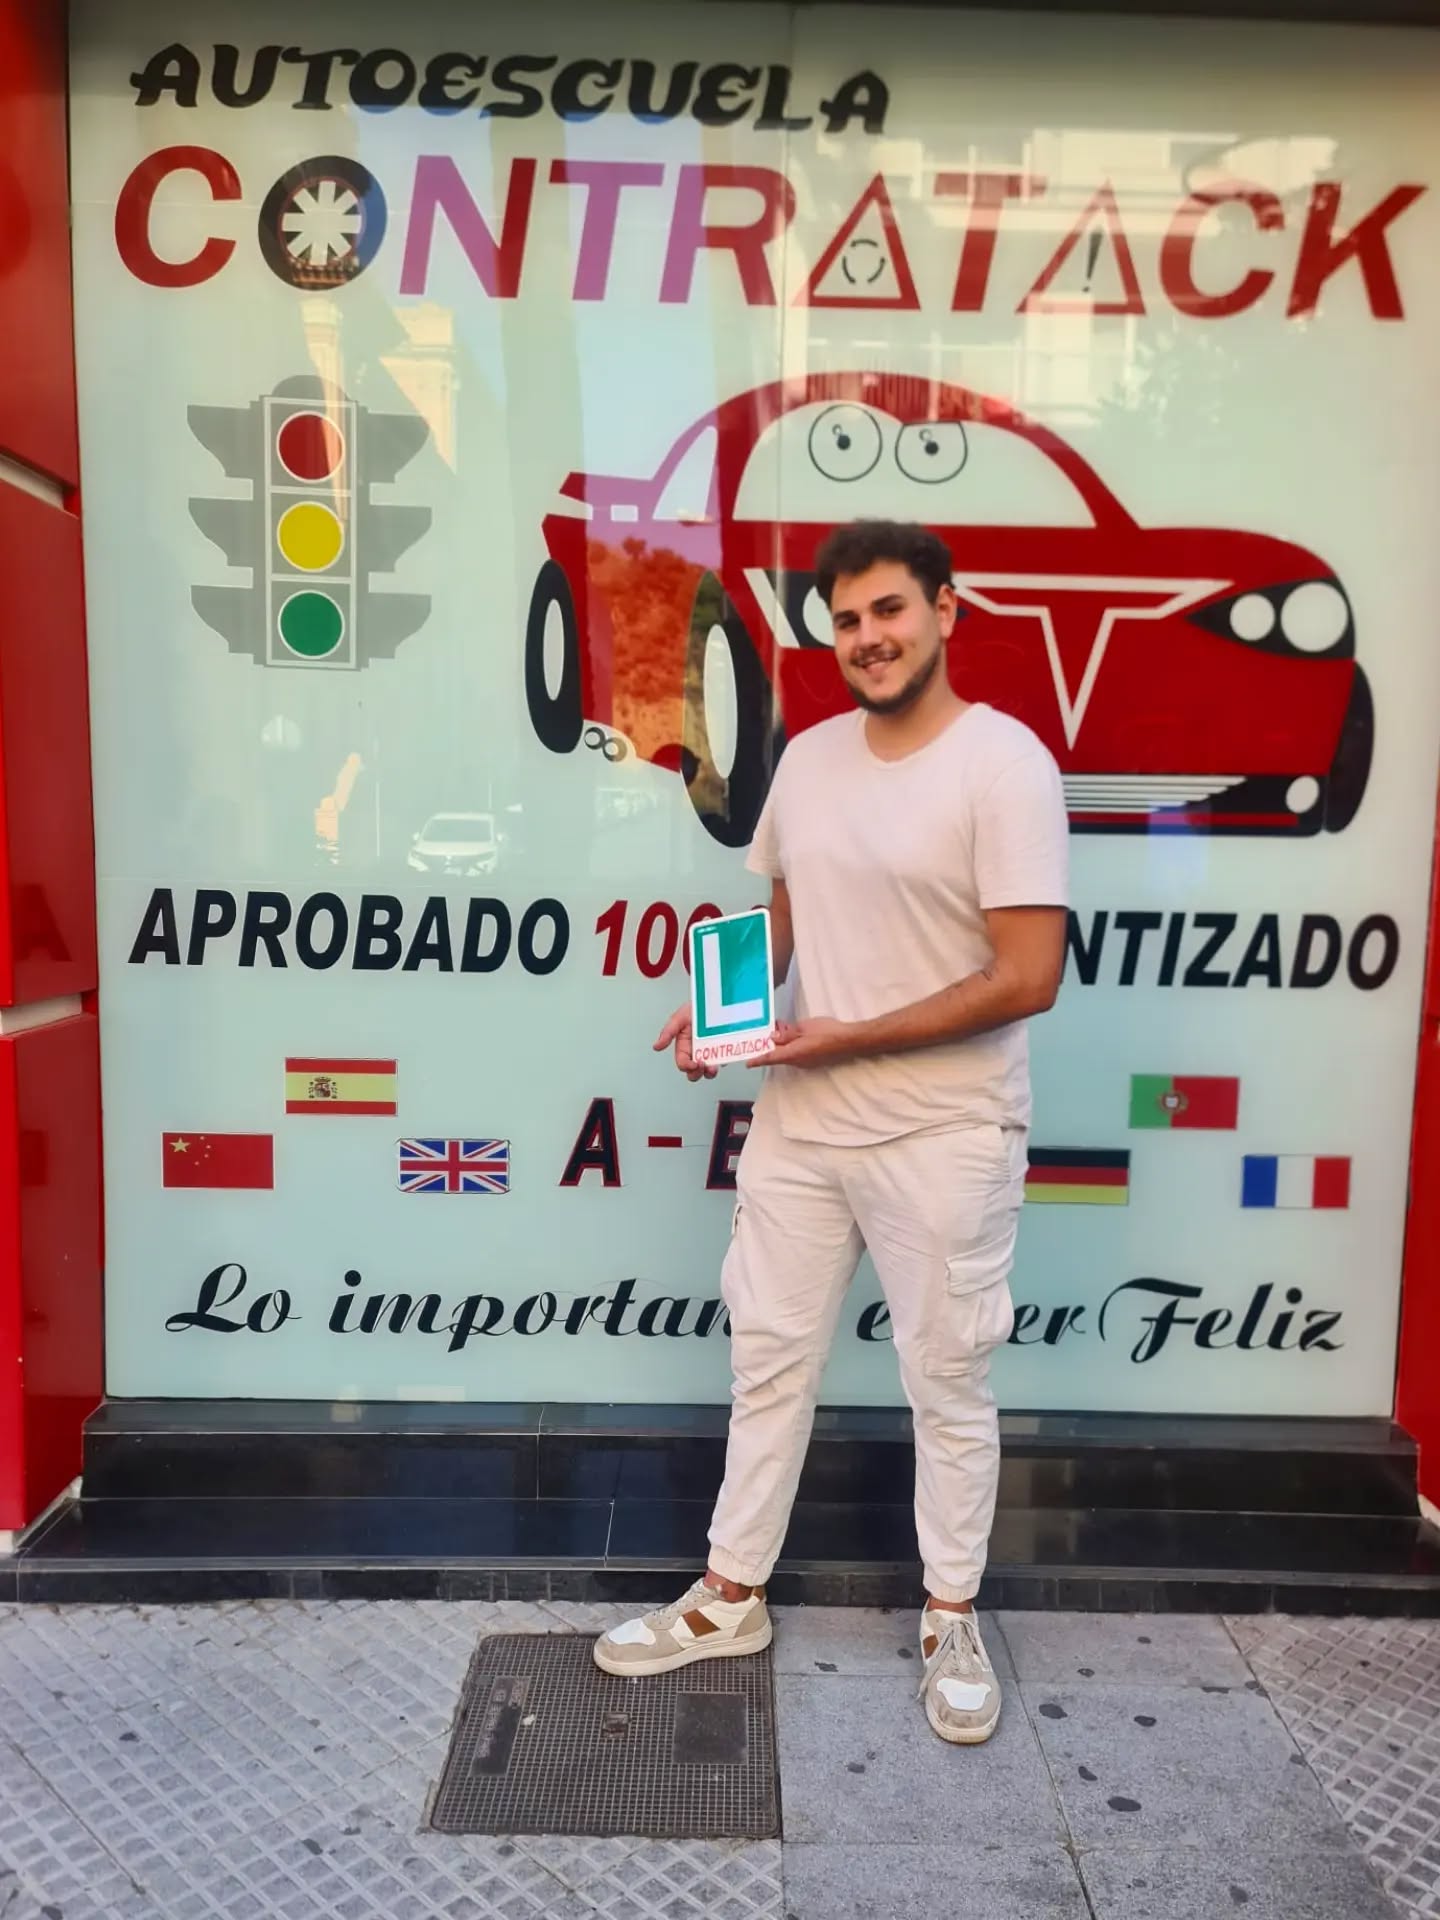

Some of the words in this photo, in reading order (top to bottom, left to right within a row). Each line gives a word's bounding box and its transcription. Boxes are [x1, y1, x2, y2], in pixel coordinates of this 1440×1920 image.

[130, 42, 890, 134] AUTOESCUELA
[115, 145, 1429, 321] CONTRATACK
[128, 887, 570, 976] APROBADO
[702, 932, 765, 1029] L
[695, 1038, 770, 1062] CONTRATACK
[559, 1097, 622, 1188] A
[165, 1262, 303, 1334] Lo
[1098, 1276, 1345, 1364] Feliz
